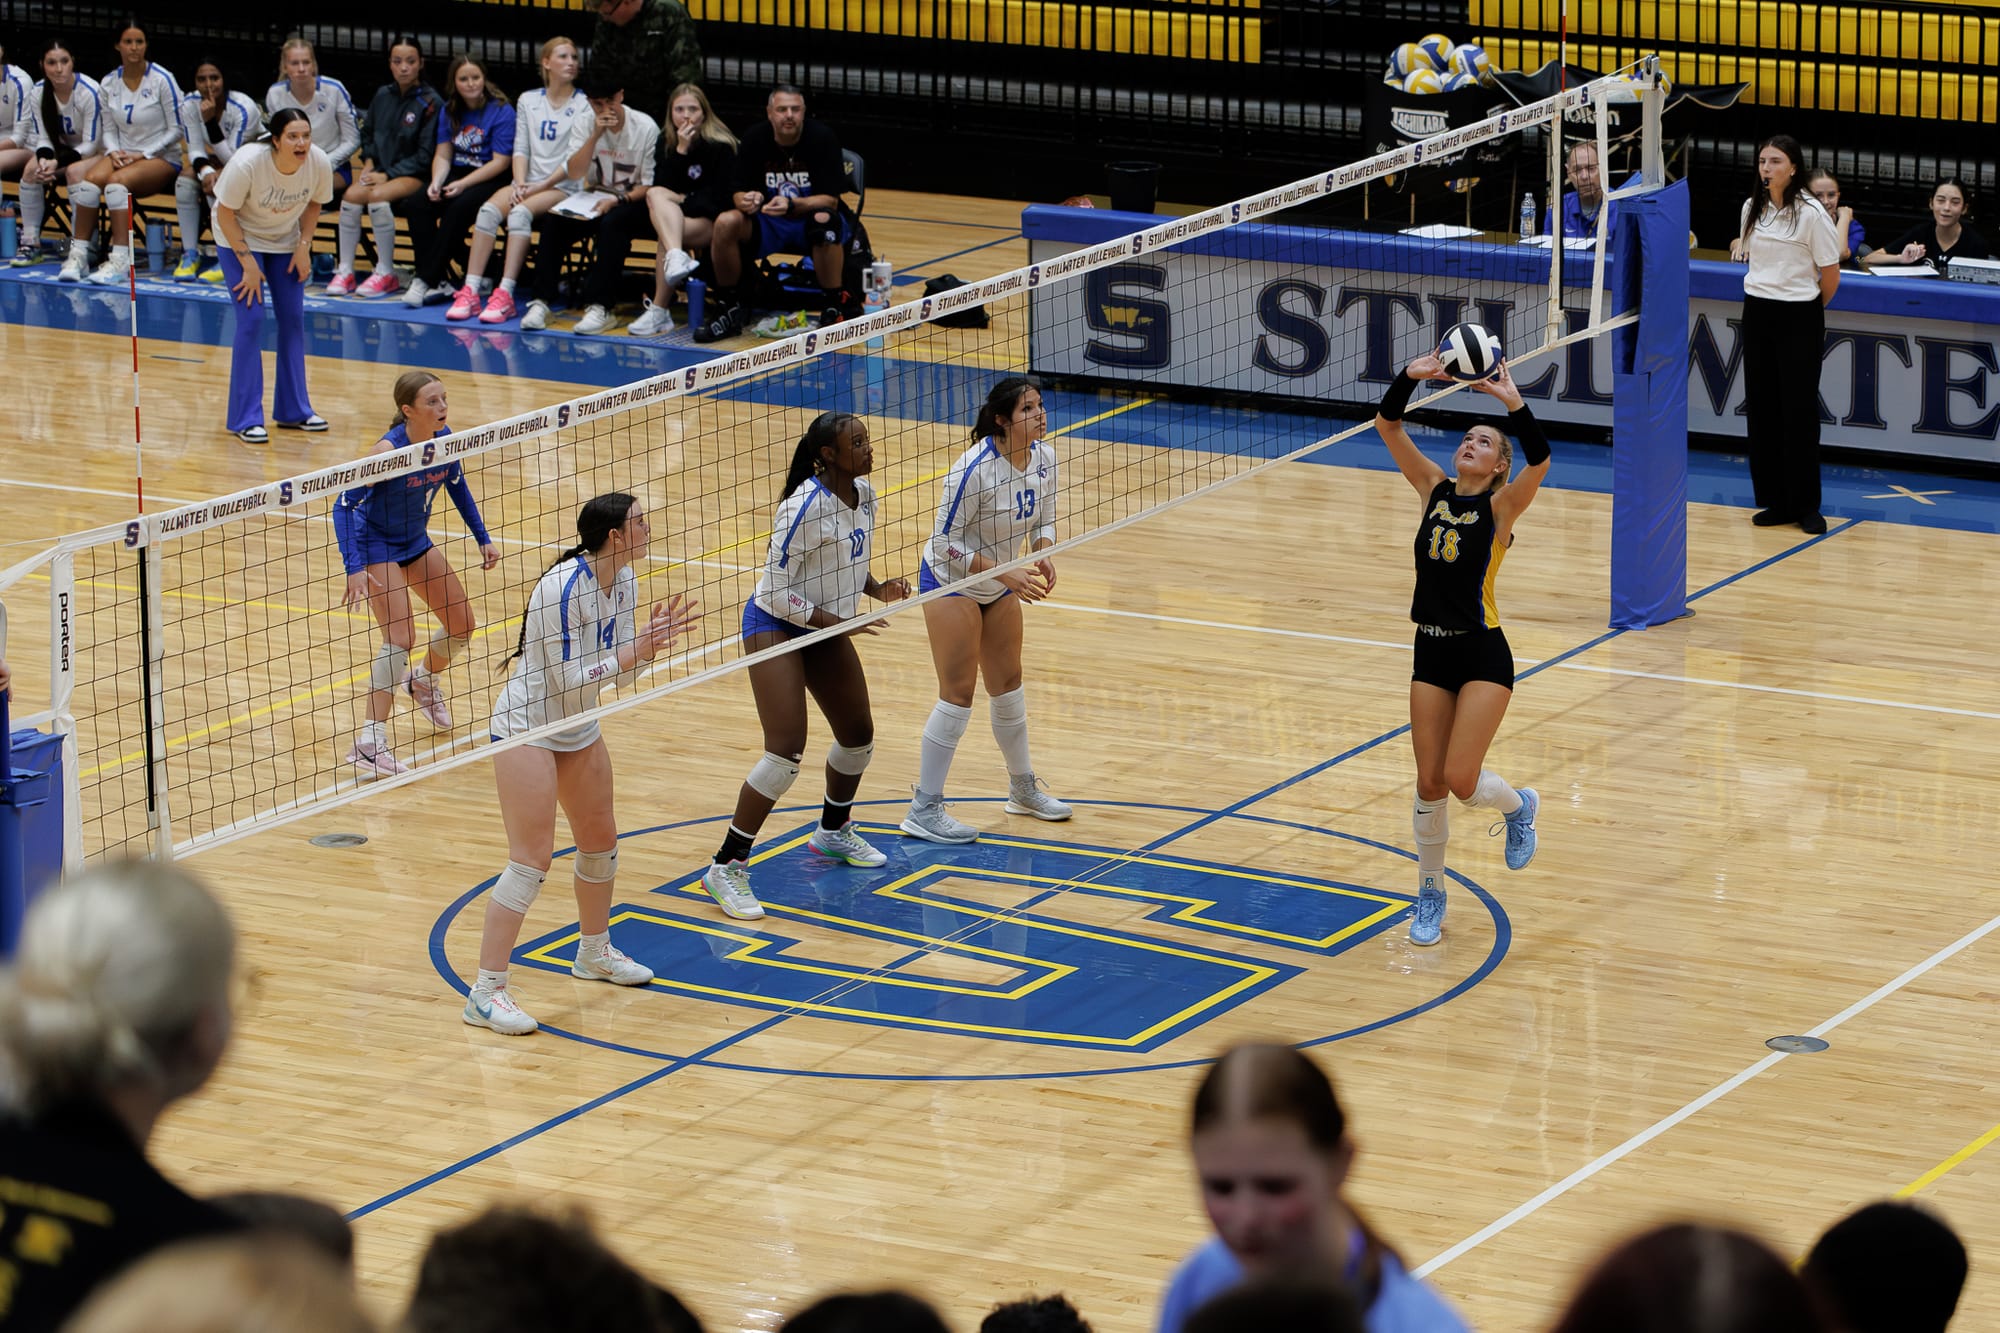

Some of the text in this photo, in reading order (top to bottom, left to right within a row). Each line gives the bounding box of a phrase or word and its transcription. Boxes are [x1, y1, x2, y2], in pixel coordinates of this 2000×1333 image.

[124, 104, 134, 124] 7
[1391, 108, 1449, 136] TACHIKARA
[1563, 106, 1620, 126] oltn
[540, 120, 558, 141] 15
[765, 172, 812, 188] GAME
[125, 522, 139, 547] S
[160, 508, 208, 533] ILLWATER
[213, 492, 267, 519] VOLLEYBALL
[279, 481, 293, 506] S
[301, 468, 357, 495] STILLWATER
[360, 453, 413, 479] VOLLEYBALL
[421, 442, 435, 466] S
[444, 431, 495, 456] STILLWATER
[499, 415, 549, 441] VOLLEYBALL
[558, 405, 570, 428] S
[577, 392, 628, 417] STILLWATER
[631, 378, 677, 402] VOLLEYBALL
[685, 367, 697, 390] S
[704, 355, 751, 380] STILLWATER
[753, 342, 798, 367] VOLLEYBALL
[805, 333, 817, 356] S
[824, 321, 869, 346] STILLWATER
[870, 308, 912, 331] VOLLEYBALL
[920, 299, 931, 320] S
[938, 287, 980, 311] STILLWATER
[982, 275, 1022, 297] VOLLEYBALL
[1028, 265, 1040, 287] S
[1045, 255, 1086, 278] STILLWATER
[1088, 244, 1127, 265] VOLLEYBALL
[1132, 234, 1143, 255] S
[1148, 224, 1187, 246] STILLWATER
[1231, 203, 1241, 224] S
[1246, 193, 1282, 215] STILLWATER
[1325, 173, 1334, 193] S
[1339, 163, 1375, 185] STILLWATER
[1413, 144, 1423, 163] S
[1427, 134, 1460, 155] STILLWATER
[1499, 115, 1508, 133] S
[1511, 106, 1543, 126] STILLWATER
[1580, 86, 1588, 104] S
[1084, 262, 1170, 369] S
[1253, 278, 2000, 441] STILLWTE
[1016, 489, 1035, 520] 13
[849, 528, 865, 561] 10
[1429, 525, 1461, 562] 18
[597, 617, 616, 650] 14
